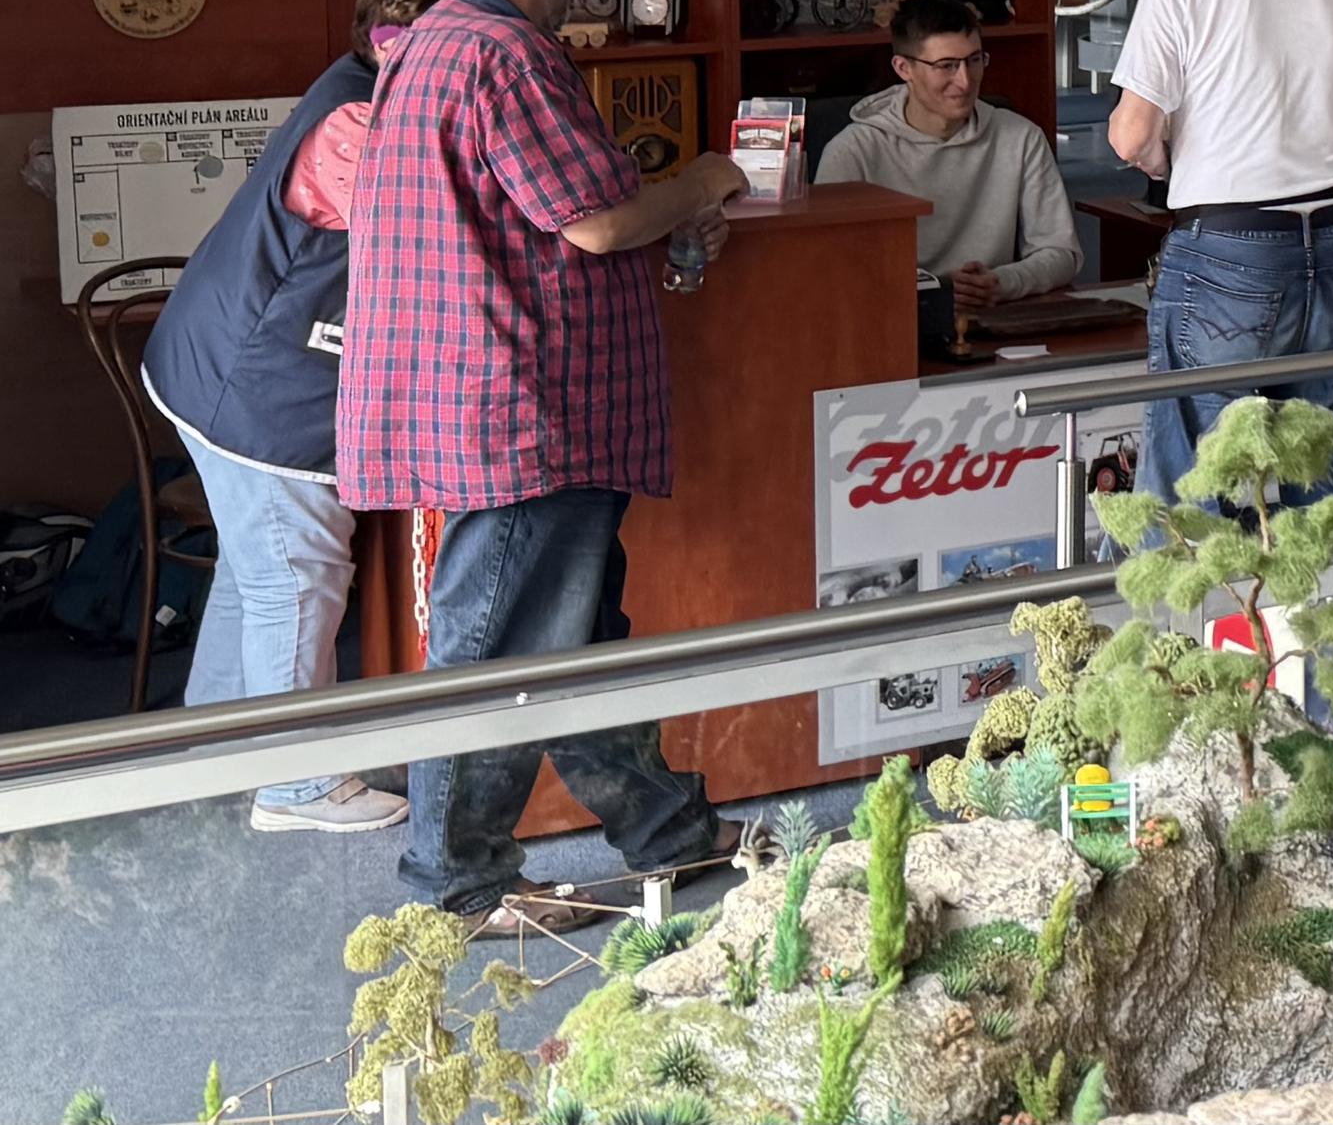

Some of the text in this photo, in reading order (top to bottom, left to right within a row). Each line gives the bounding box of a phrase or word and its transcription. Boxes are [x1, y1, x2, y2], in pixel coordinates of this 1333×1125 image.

[117, 106, 269, 128] ORIENTAČNÍ PLÁN AREÁLU
[846, 439, 1060, 509] Zetor
